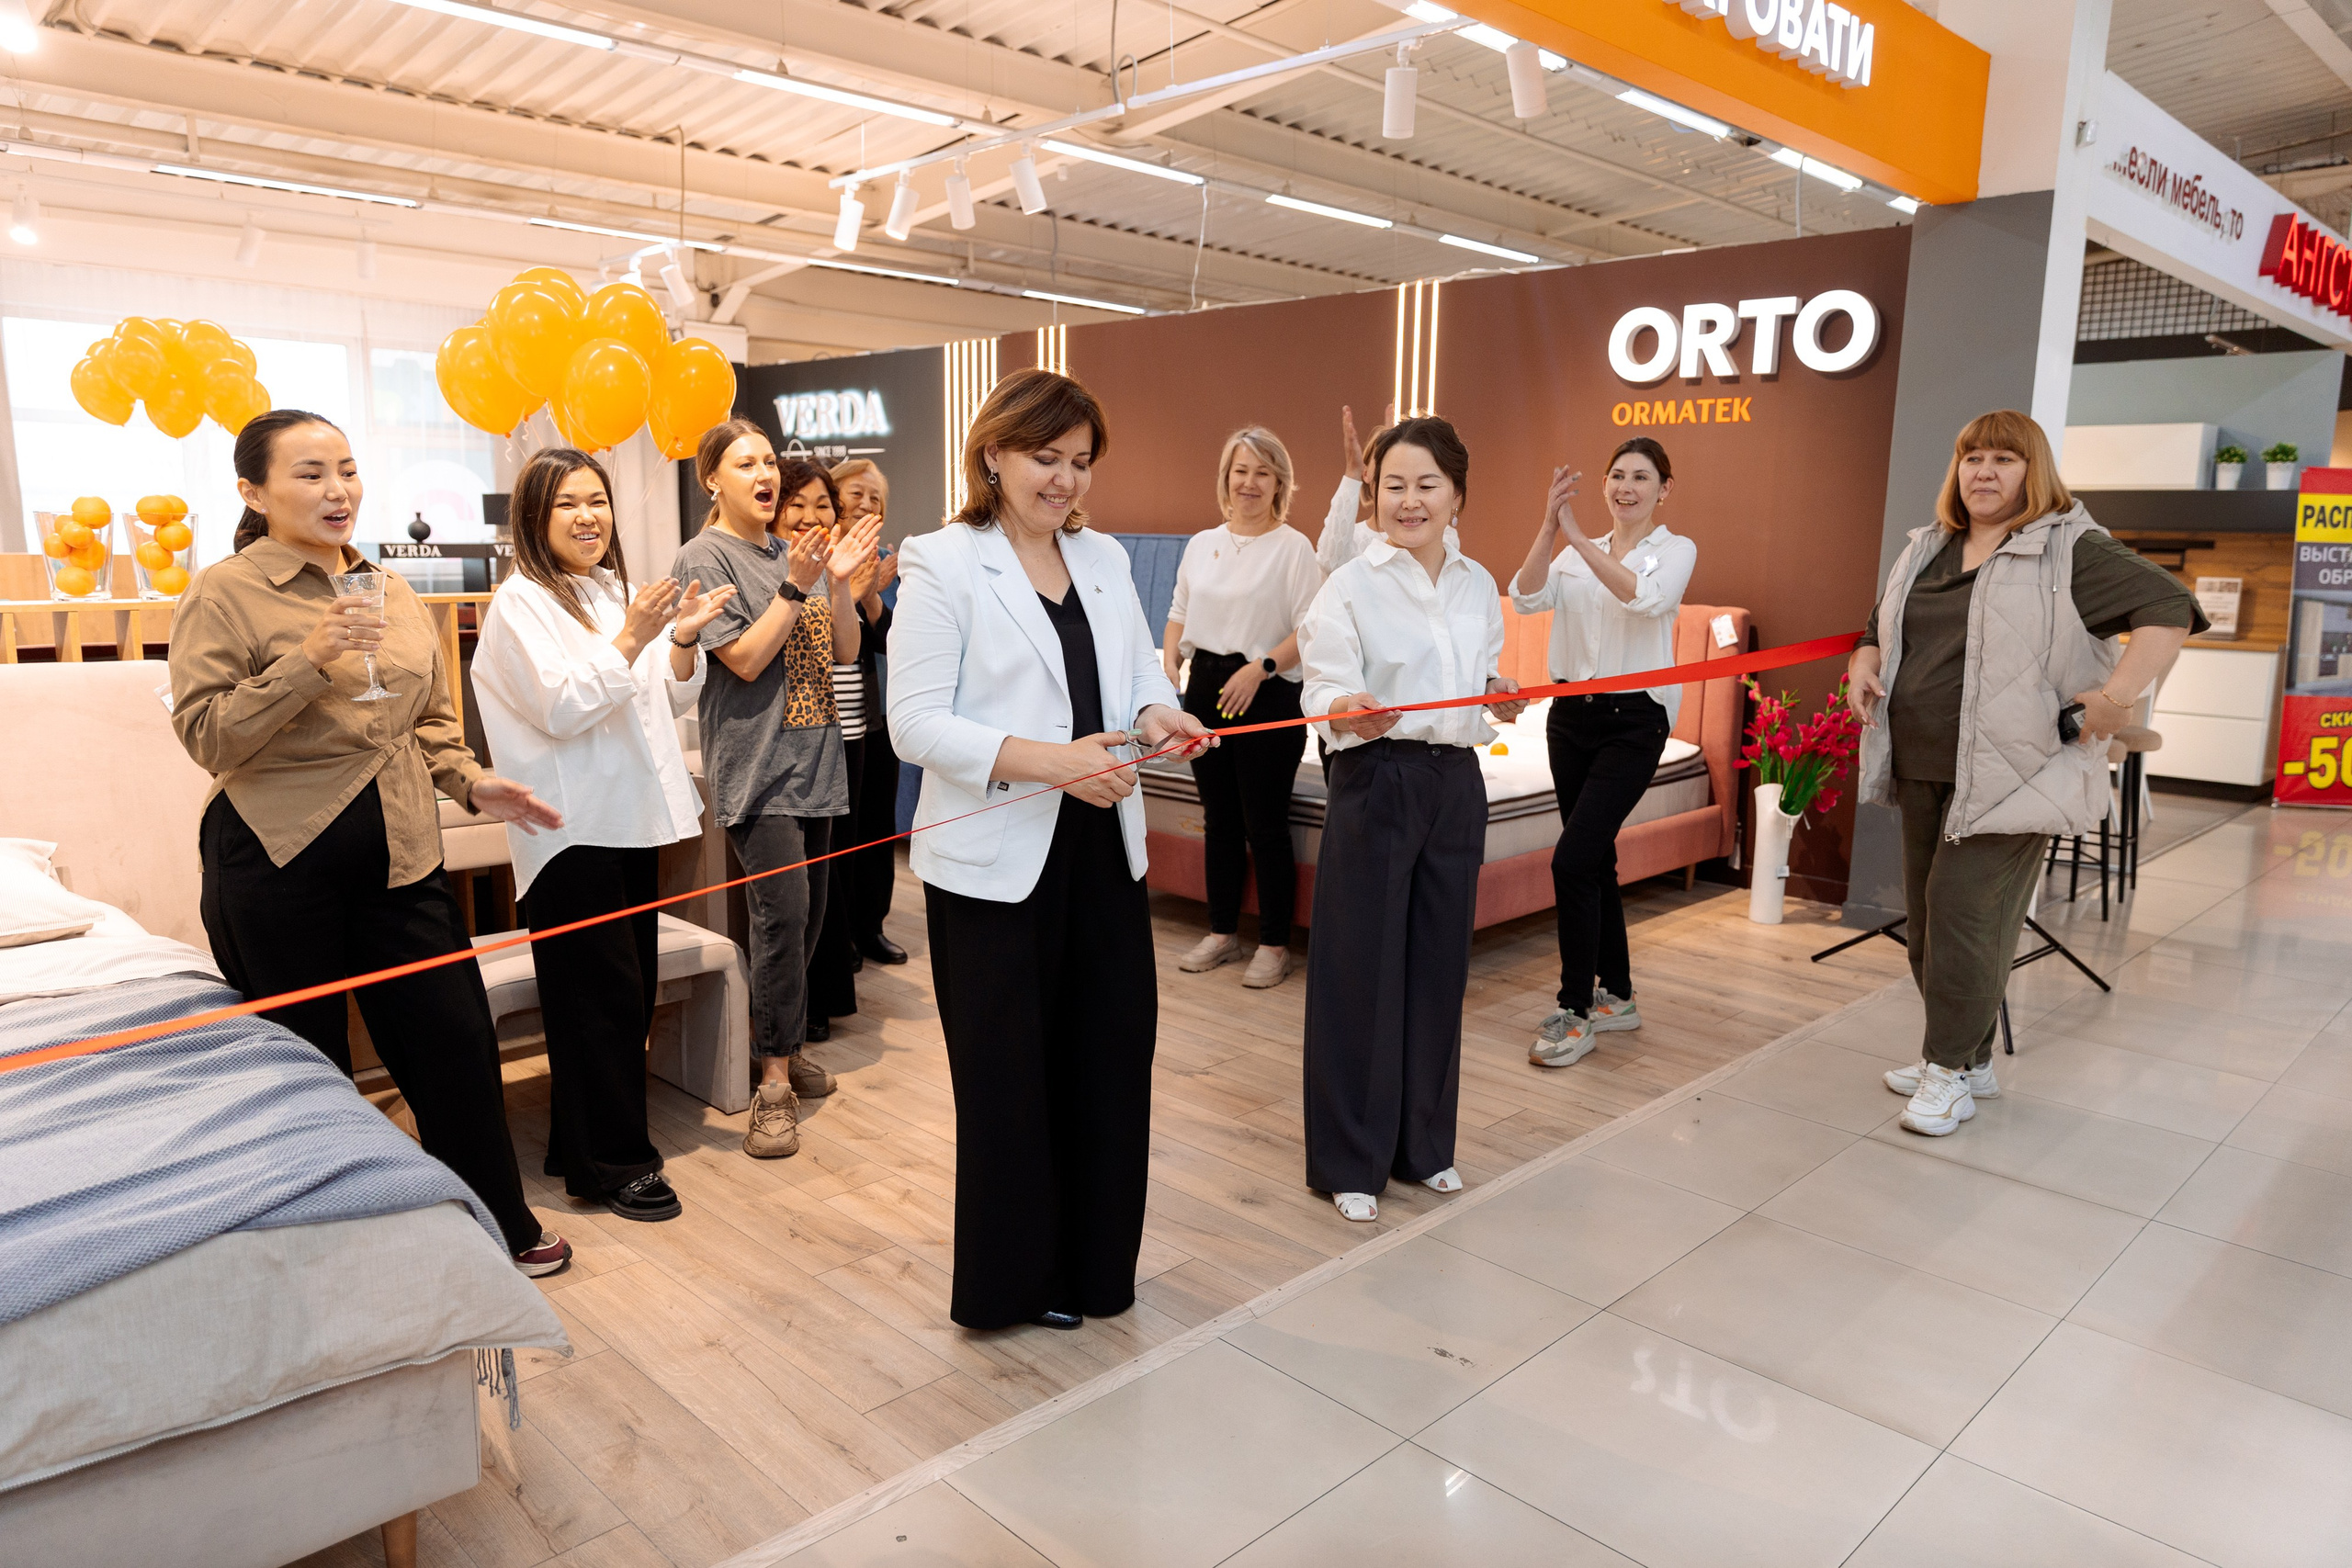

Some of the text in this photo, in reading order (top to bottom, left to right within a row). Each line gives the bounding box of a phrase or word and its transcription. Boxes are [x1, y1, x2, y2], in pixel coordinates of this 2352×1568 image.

[2230, 208, 2244, 241] то
[1608, 289, 1879, 383] ORTO
[773, 389, 889, 437] VERDA
[1611, 397, 1753, 426] ORMATEK
[384, 544, 442, 558] VERDA
[2299, 545, 2352, 563] ВЫСТ
